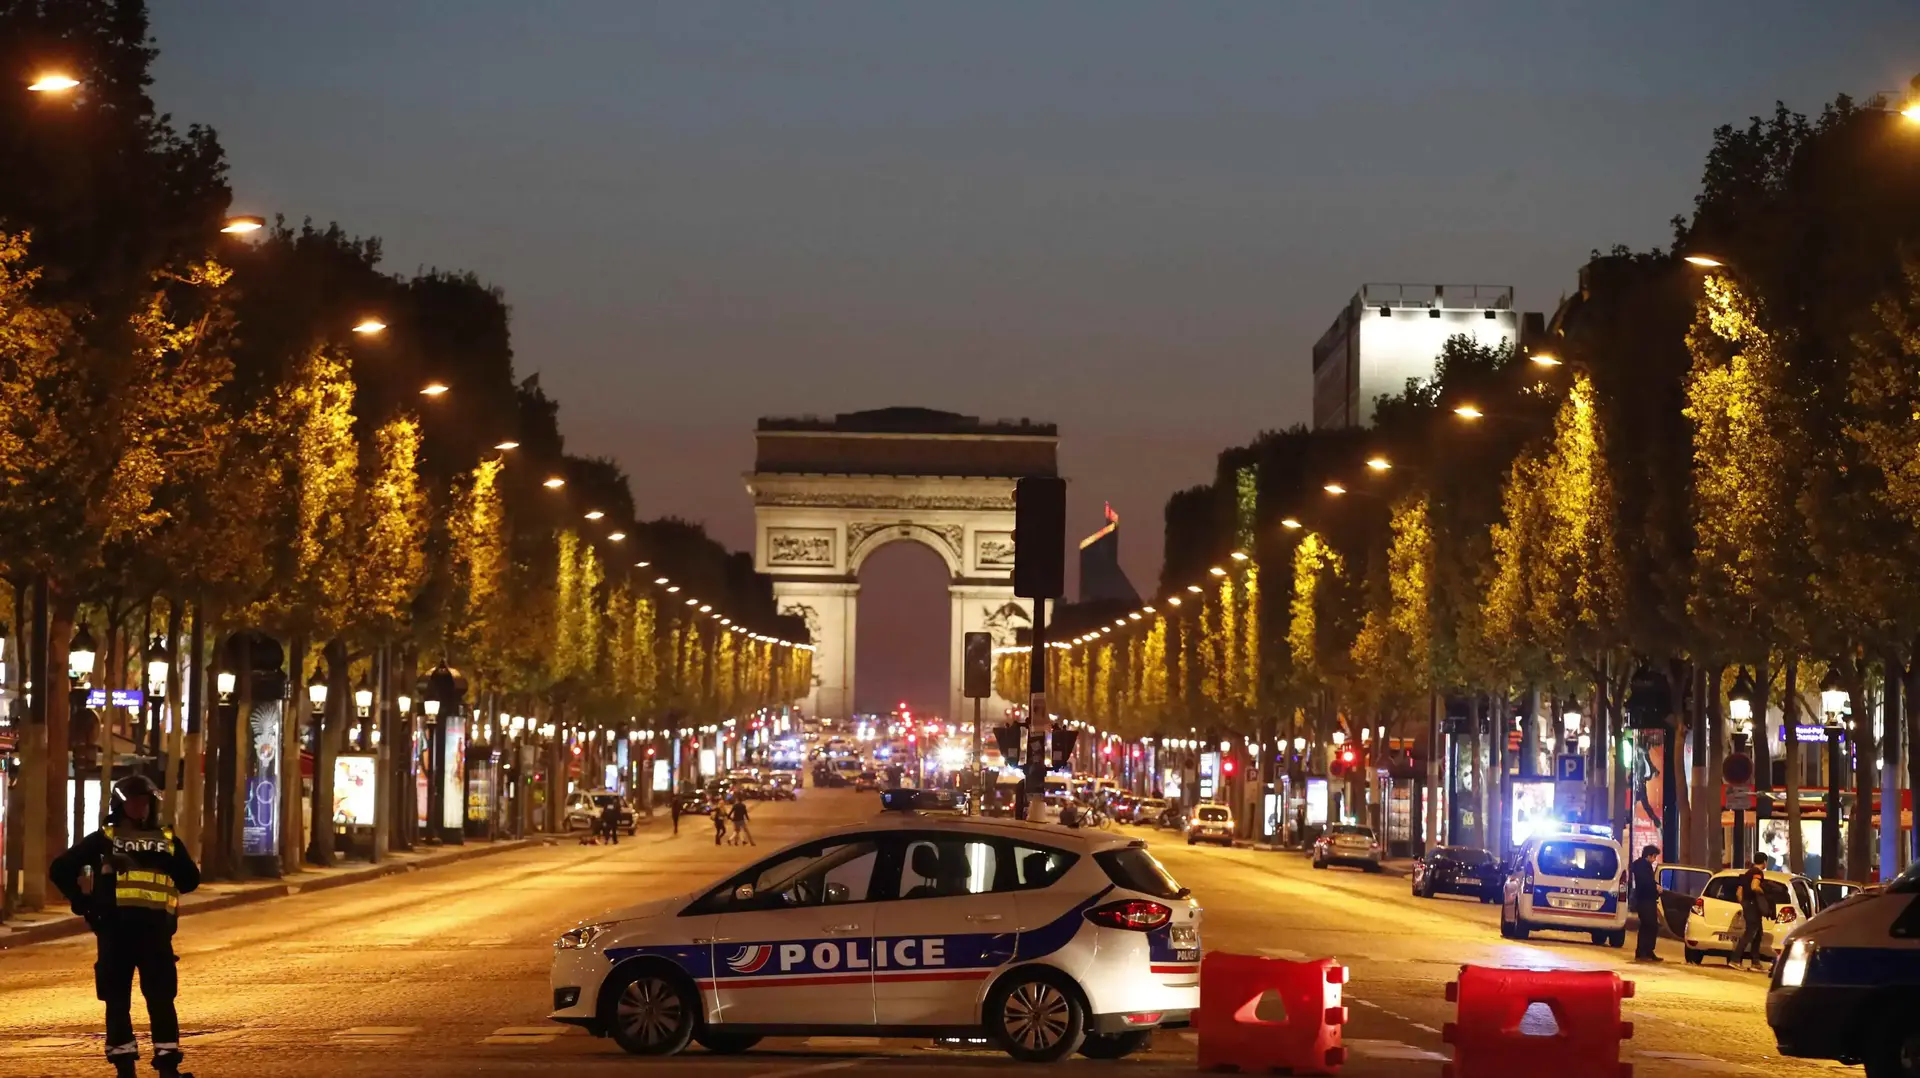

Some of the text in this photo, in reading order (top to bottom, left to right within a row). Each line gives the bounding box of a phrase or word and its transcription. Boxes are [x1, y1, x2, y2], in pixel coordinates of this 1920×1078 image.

[1565, 759, 1577, 777] P
[1560, 887, 1592, 895] POLICE
[780, 938, 946, 971] POLICE
